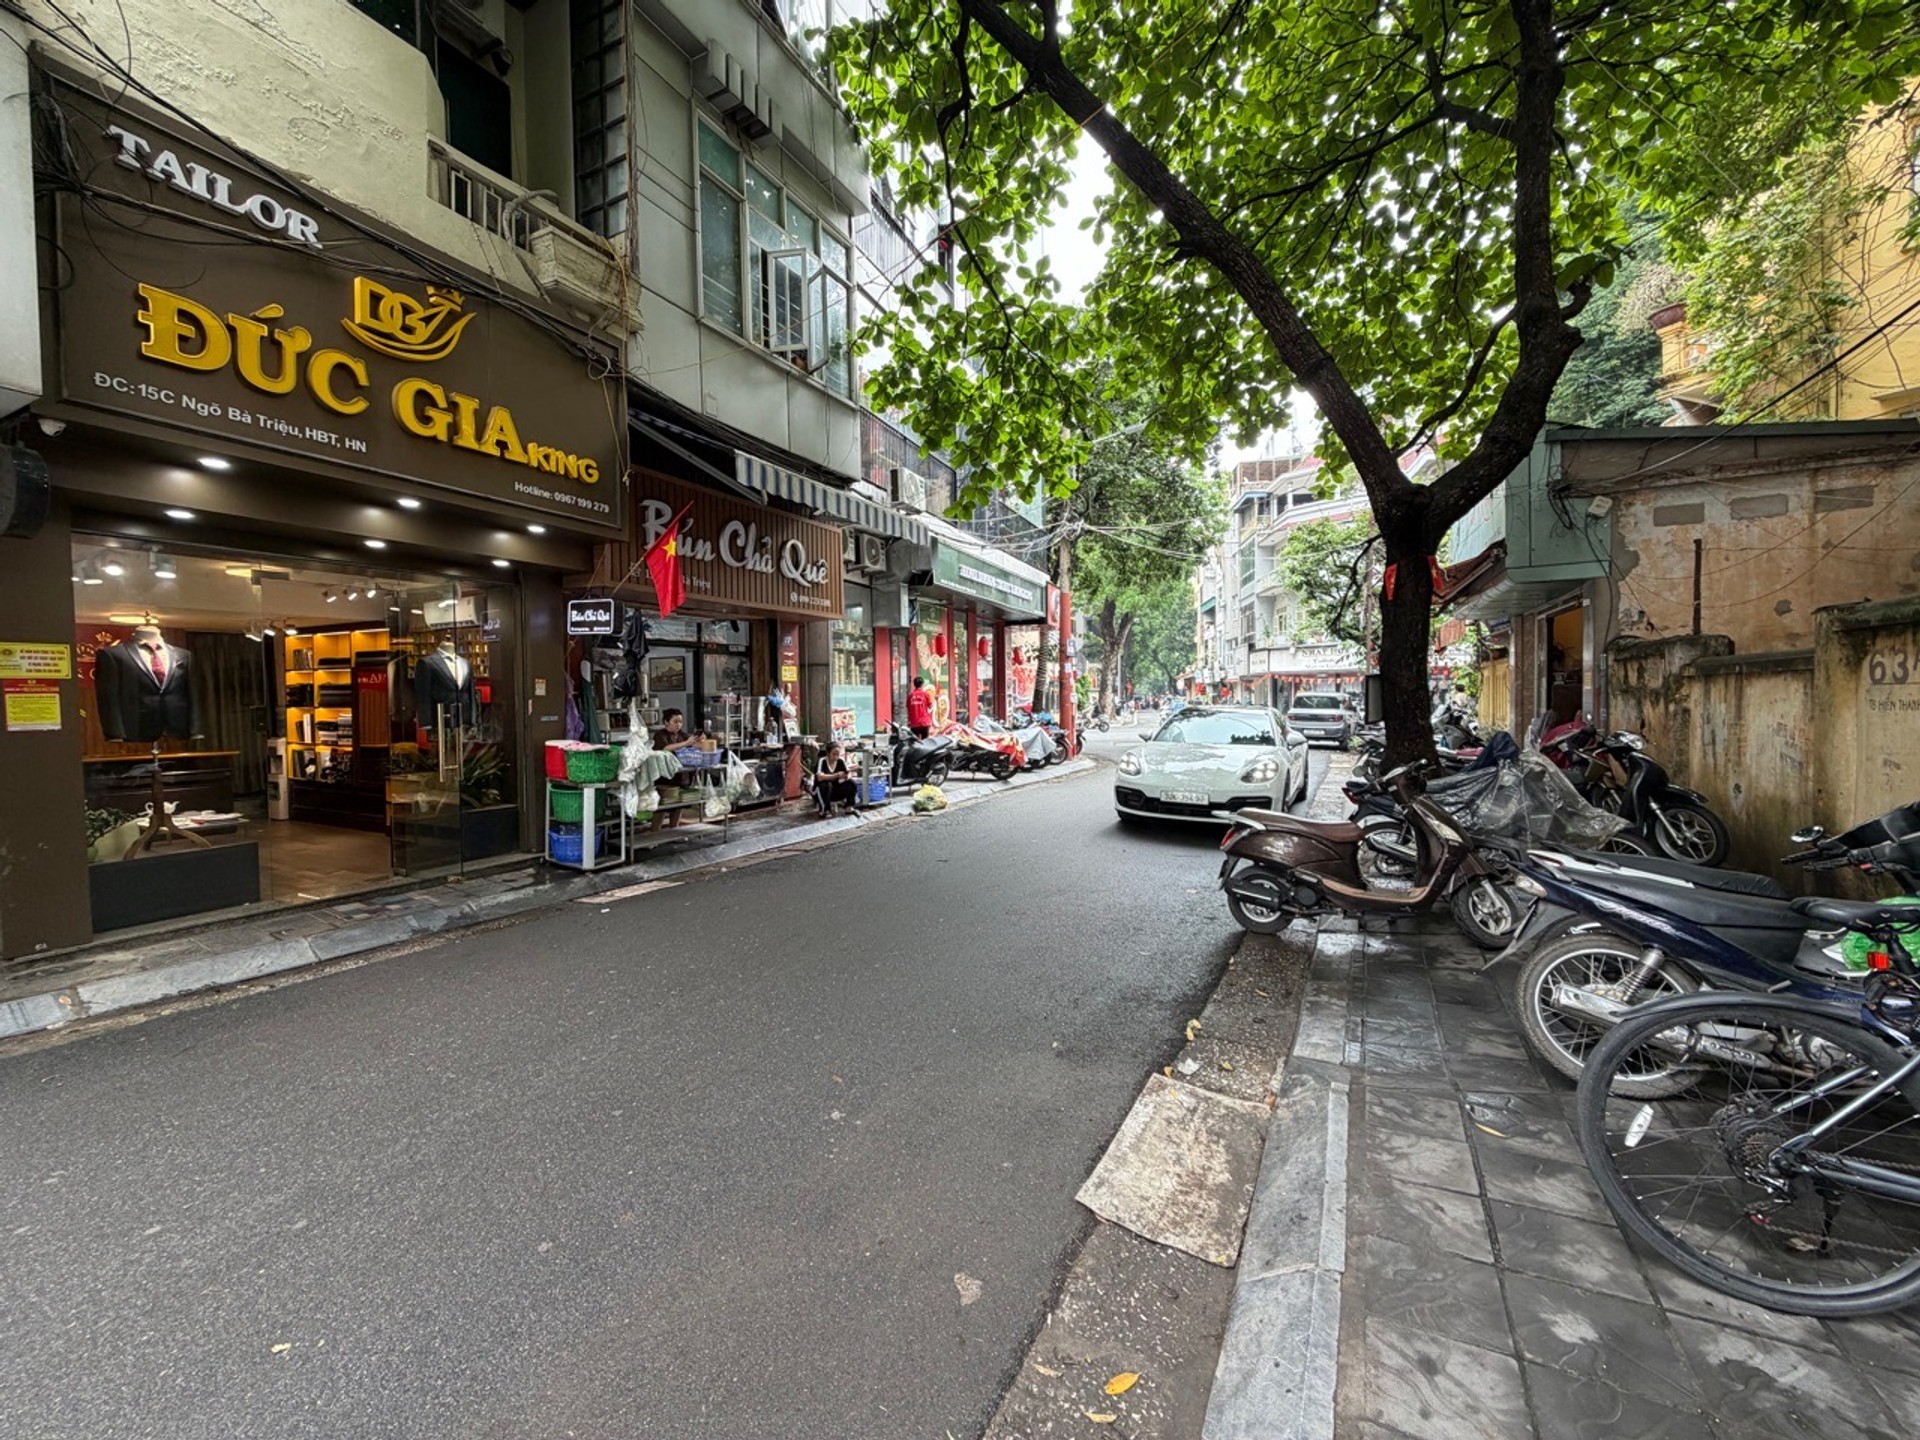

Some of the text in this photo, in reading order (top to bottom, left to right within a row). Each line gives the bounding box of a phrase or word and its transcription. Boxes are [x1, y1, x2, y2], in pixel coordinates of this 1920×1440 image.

[103, 125, 323, 249] TAILOR
[137, 282, 600, 484] ĐỨC GIA KING
[181, 394, 222, 416] Ngõ
[227, 408, 252, 425] Bà
[345, 437, 368, 453] HN
[514, 481, 553, 499] Hotline:
[639, 499, 829, 588] Bún Chả Quê
